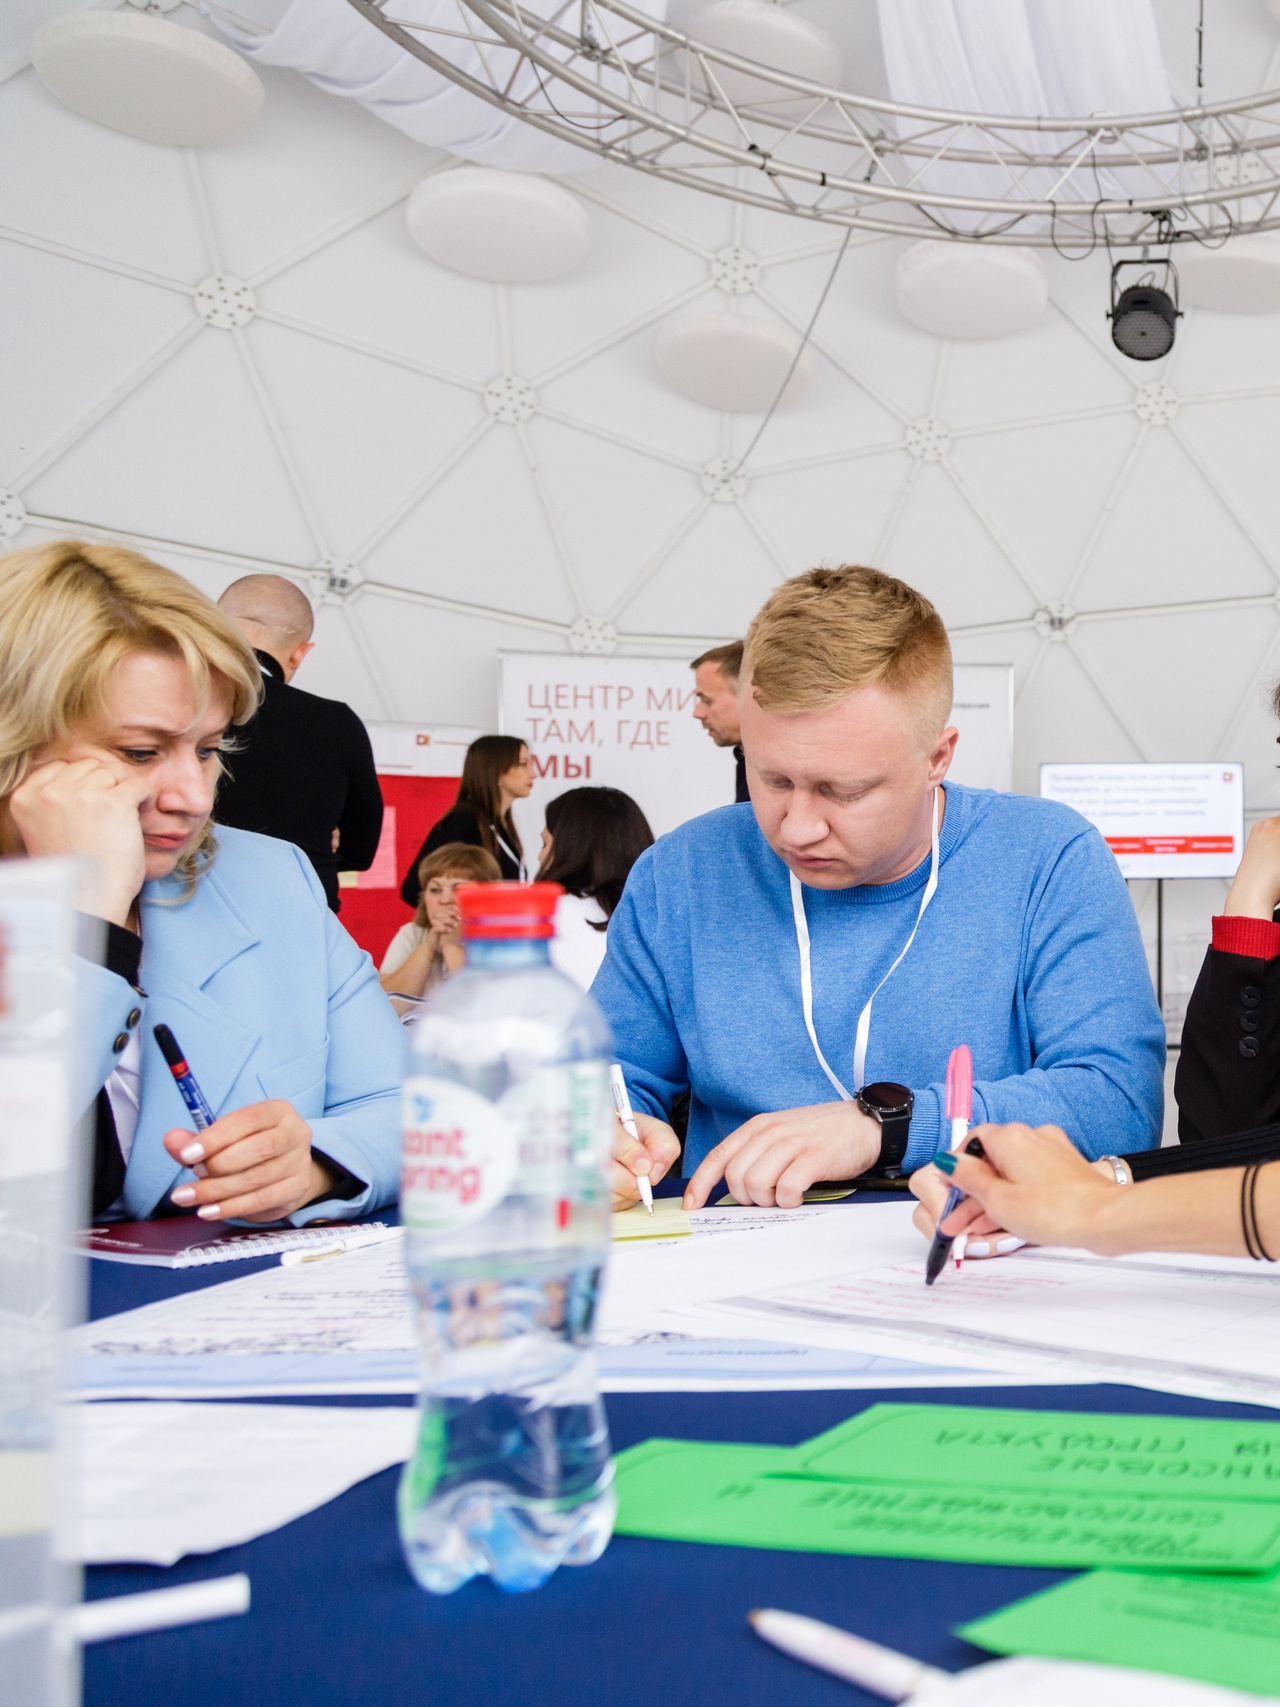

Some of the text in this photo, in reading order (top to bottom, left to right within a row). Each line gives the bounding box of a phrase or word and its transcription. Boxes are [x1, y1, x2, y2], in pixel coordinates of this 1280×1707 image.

[527, 683, 698, 715] ЦЕНТР МИ
[526, 718, 671, 751] ТАМ, ГДЕ
[532, 754, 592, 779] МЫ
[934, 1427, 1187, 1453] ПРОДУКТА
